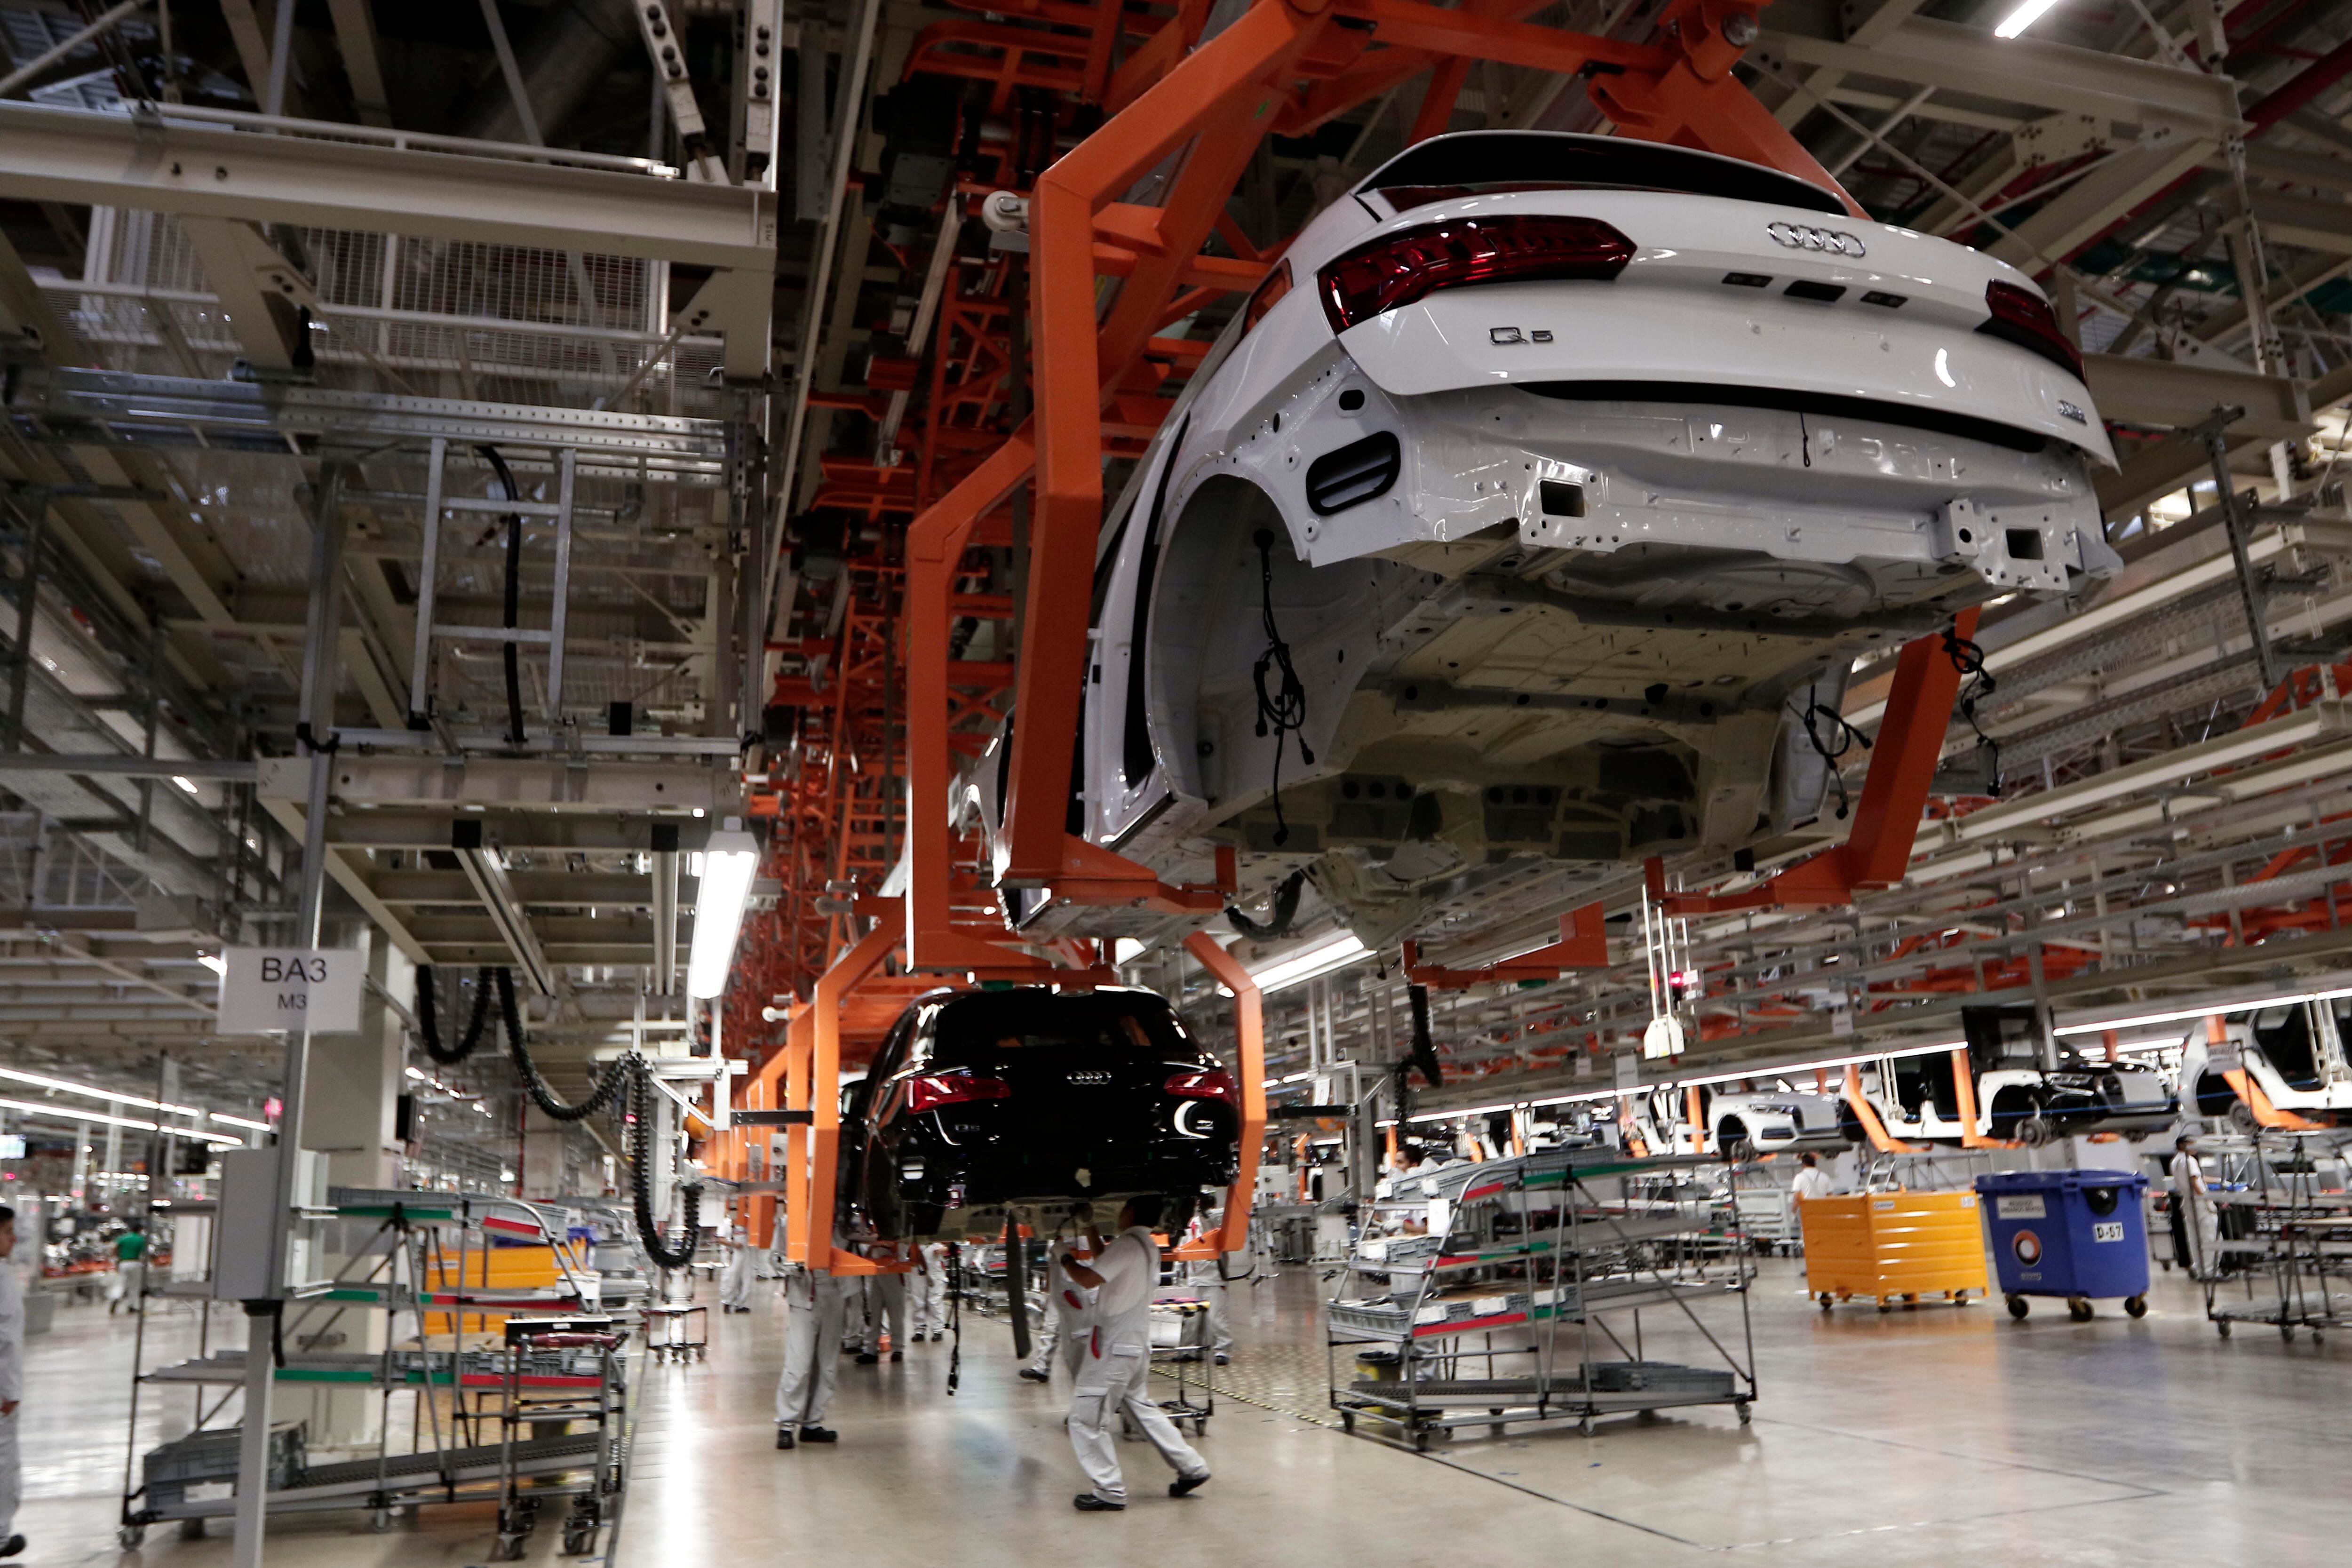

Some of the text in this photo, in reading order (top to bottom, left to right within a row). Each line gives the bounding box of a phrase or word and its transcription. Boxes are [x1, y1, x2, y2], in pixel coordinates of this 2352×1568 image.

[1488, 326, 1554, 345] Q5
[262, 957, 326, 983] BA3
[278, 993, 307, 1010] M3
